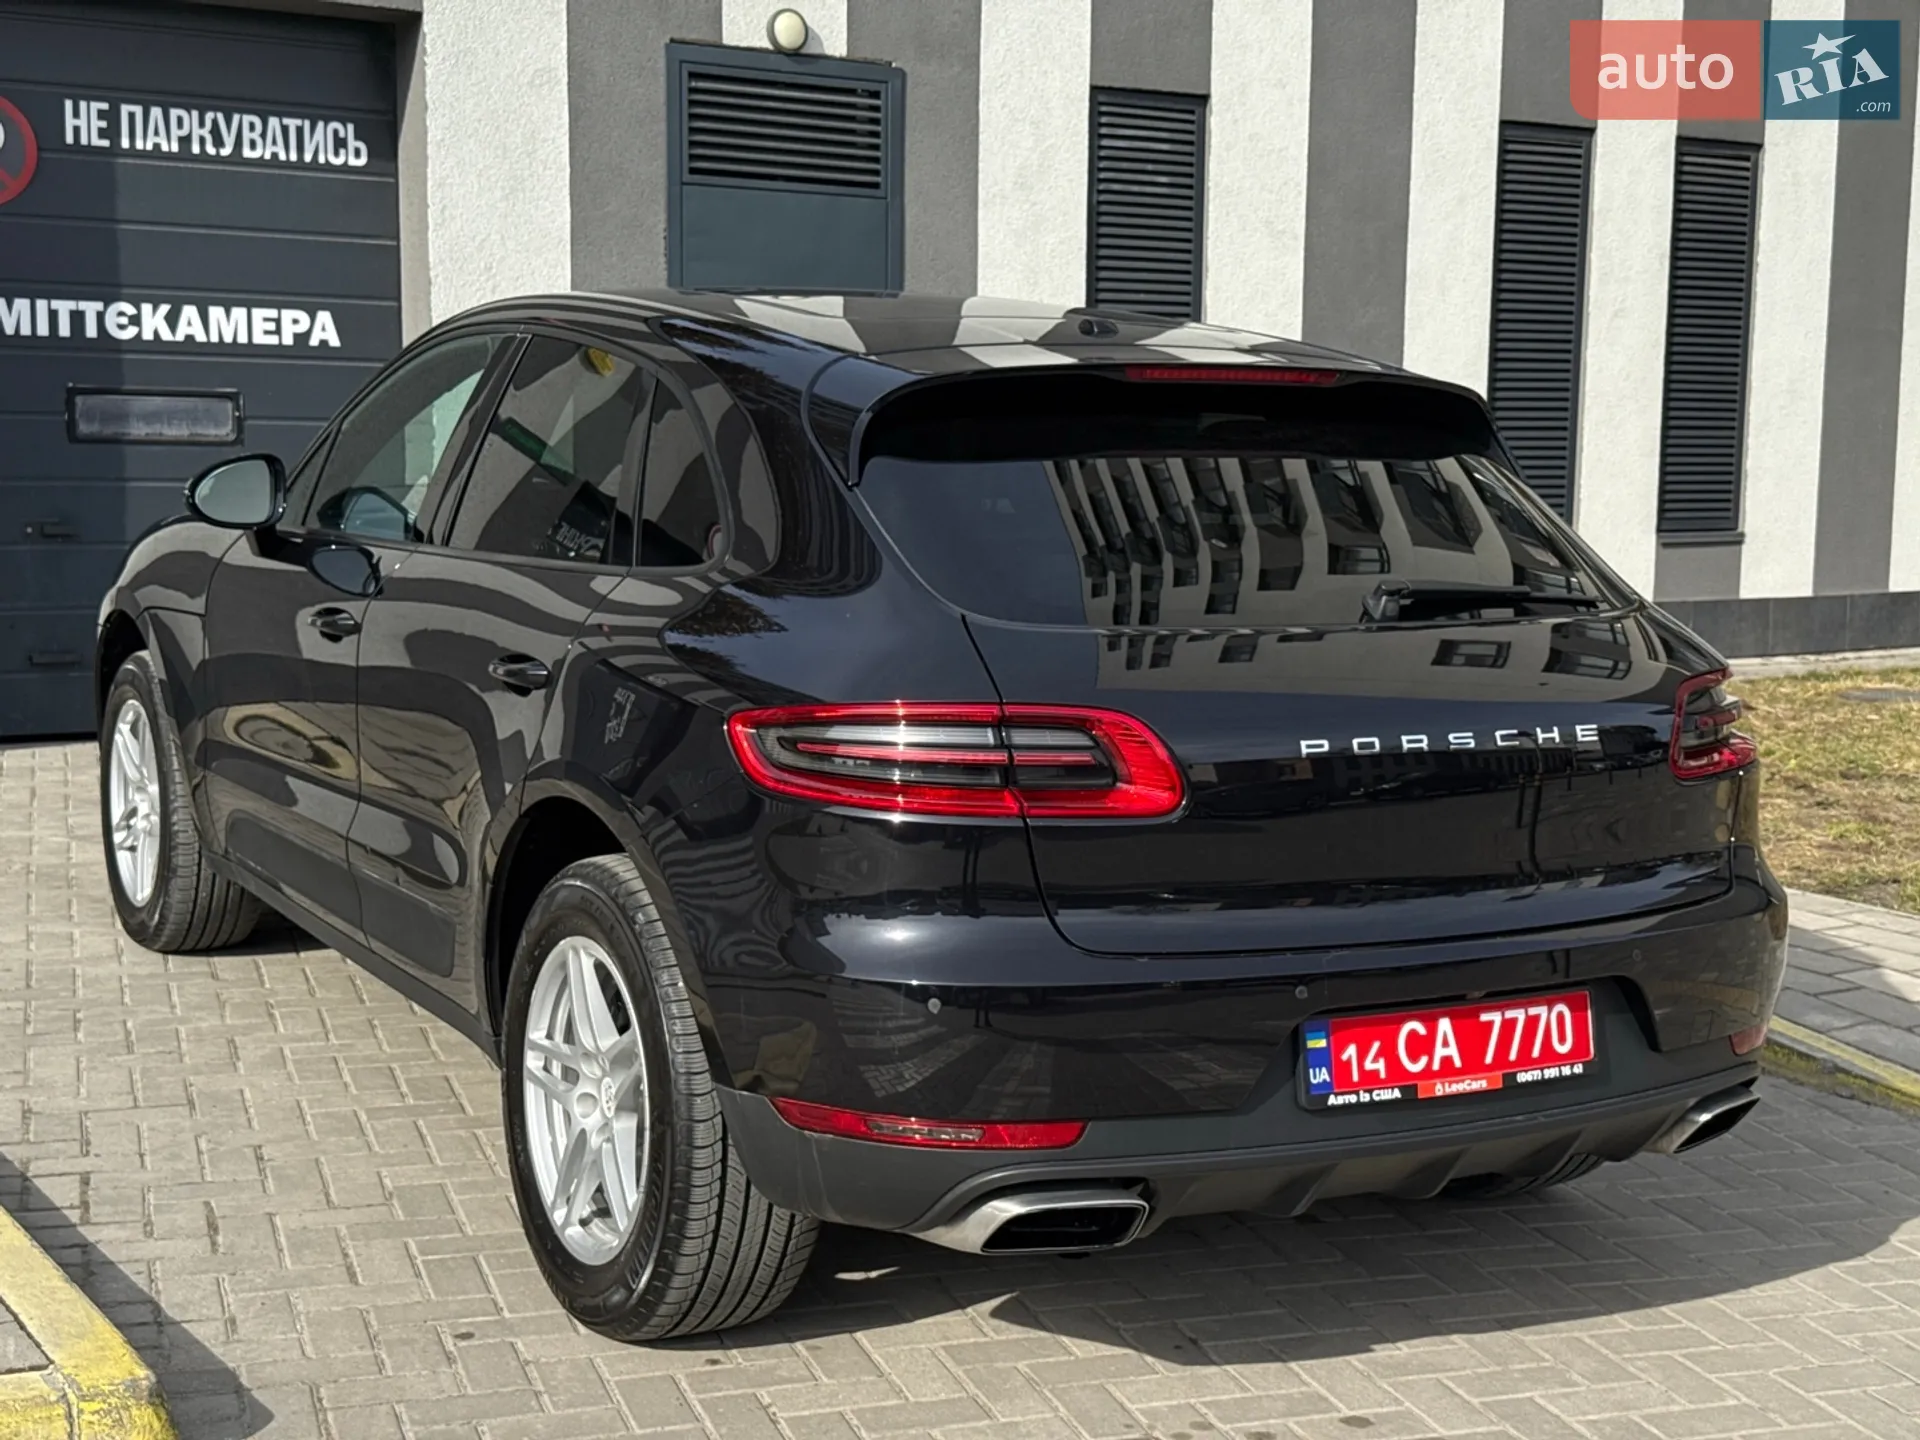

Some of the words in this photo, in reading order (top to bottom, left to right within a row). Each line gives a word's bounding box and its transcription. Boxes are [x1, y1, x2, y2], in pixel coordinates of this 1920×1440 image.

[63, 98, 110, 147] НЕ
[119, 103, 368, 167] ПАРКУВАТИСЬ
[1299, 724, 1600, 758] PORSCHE
[1339, 1040, 1387, 1082] 14
[1479, 1002, 1574, 1065] 7770
[1309, 1066, 1330, 1084] UA
[1444, 1079, 1488, 1093] LeoCars
[1326, 1093, 1358, 1106] Авто
[1372, 1087, 1402, 1101] США
